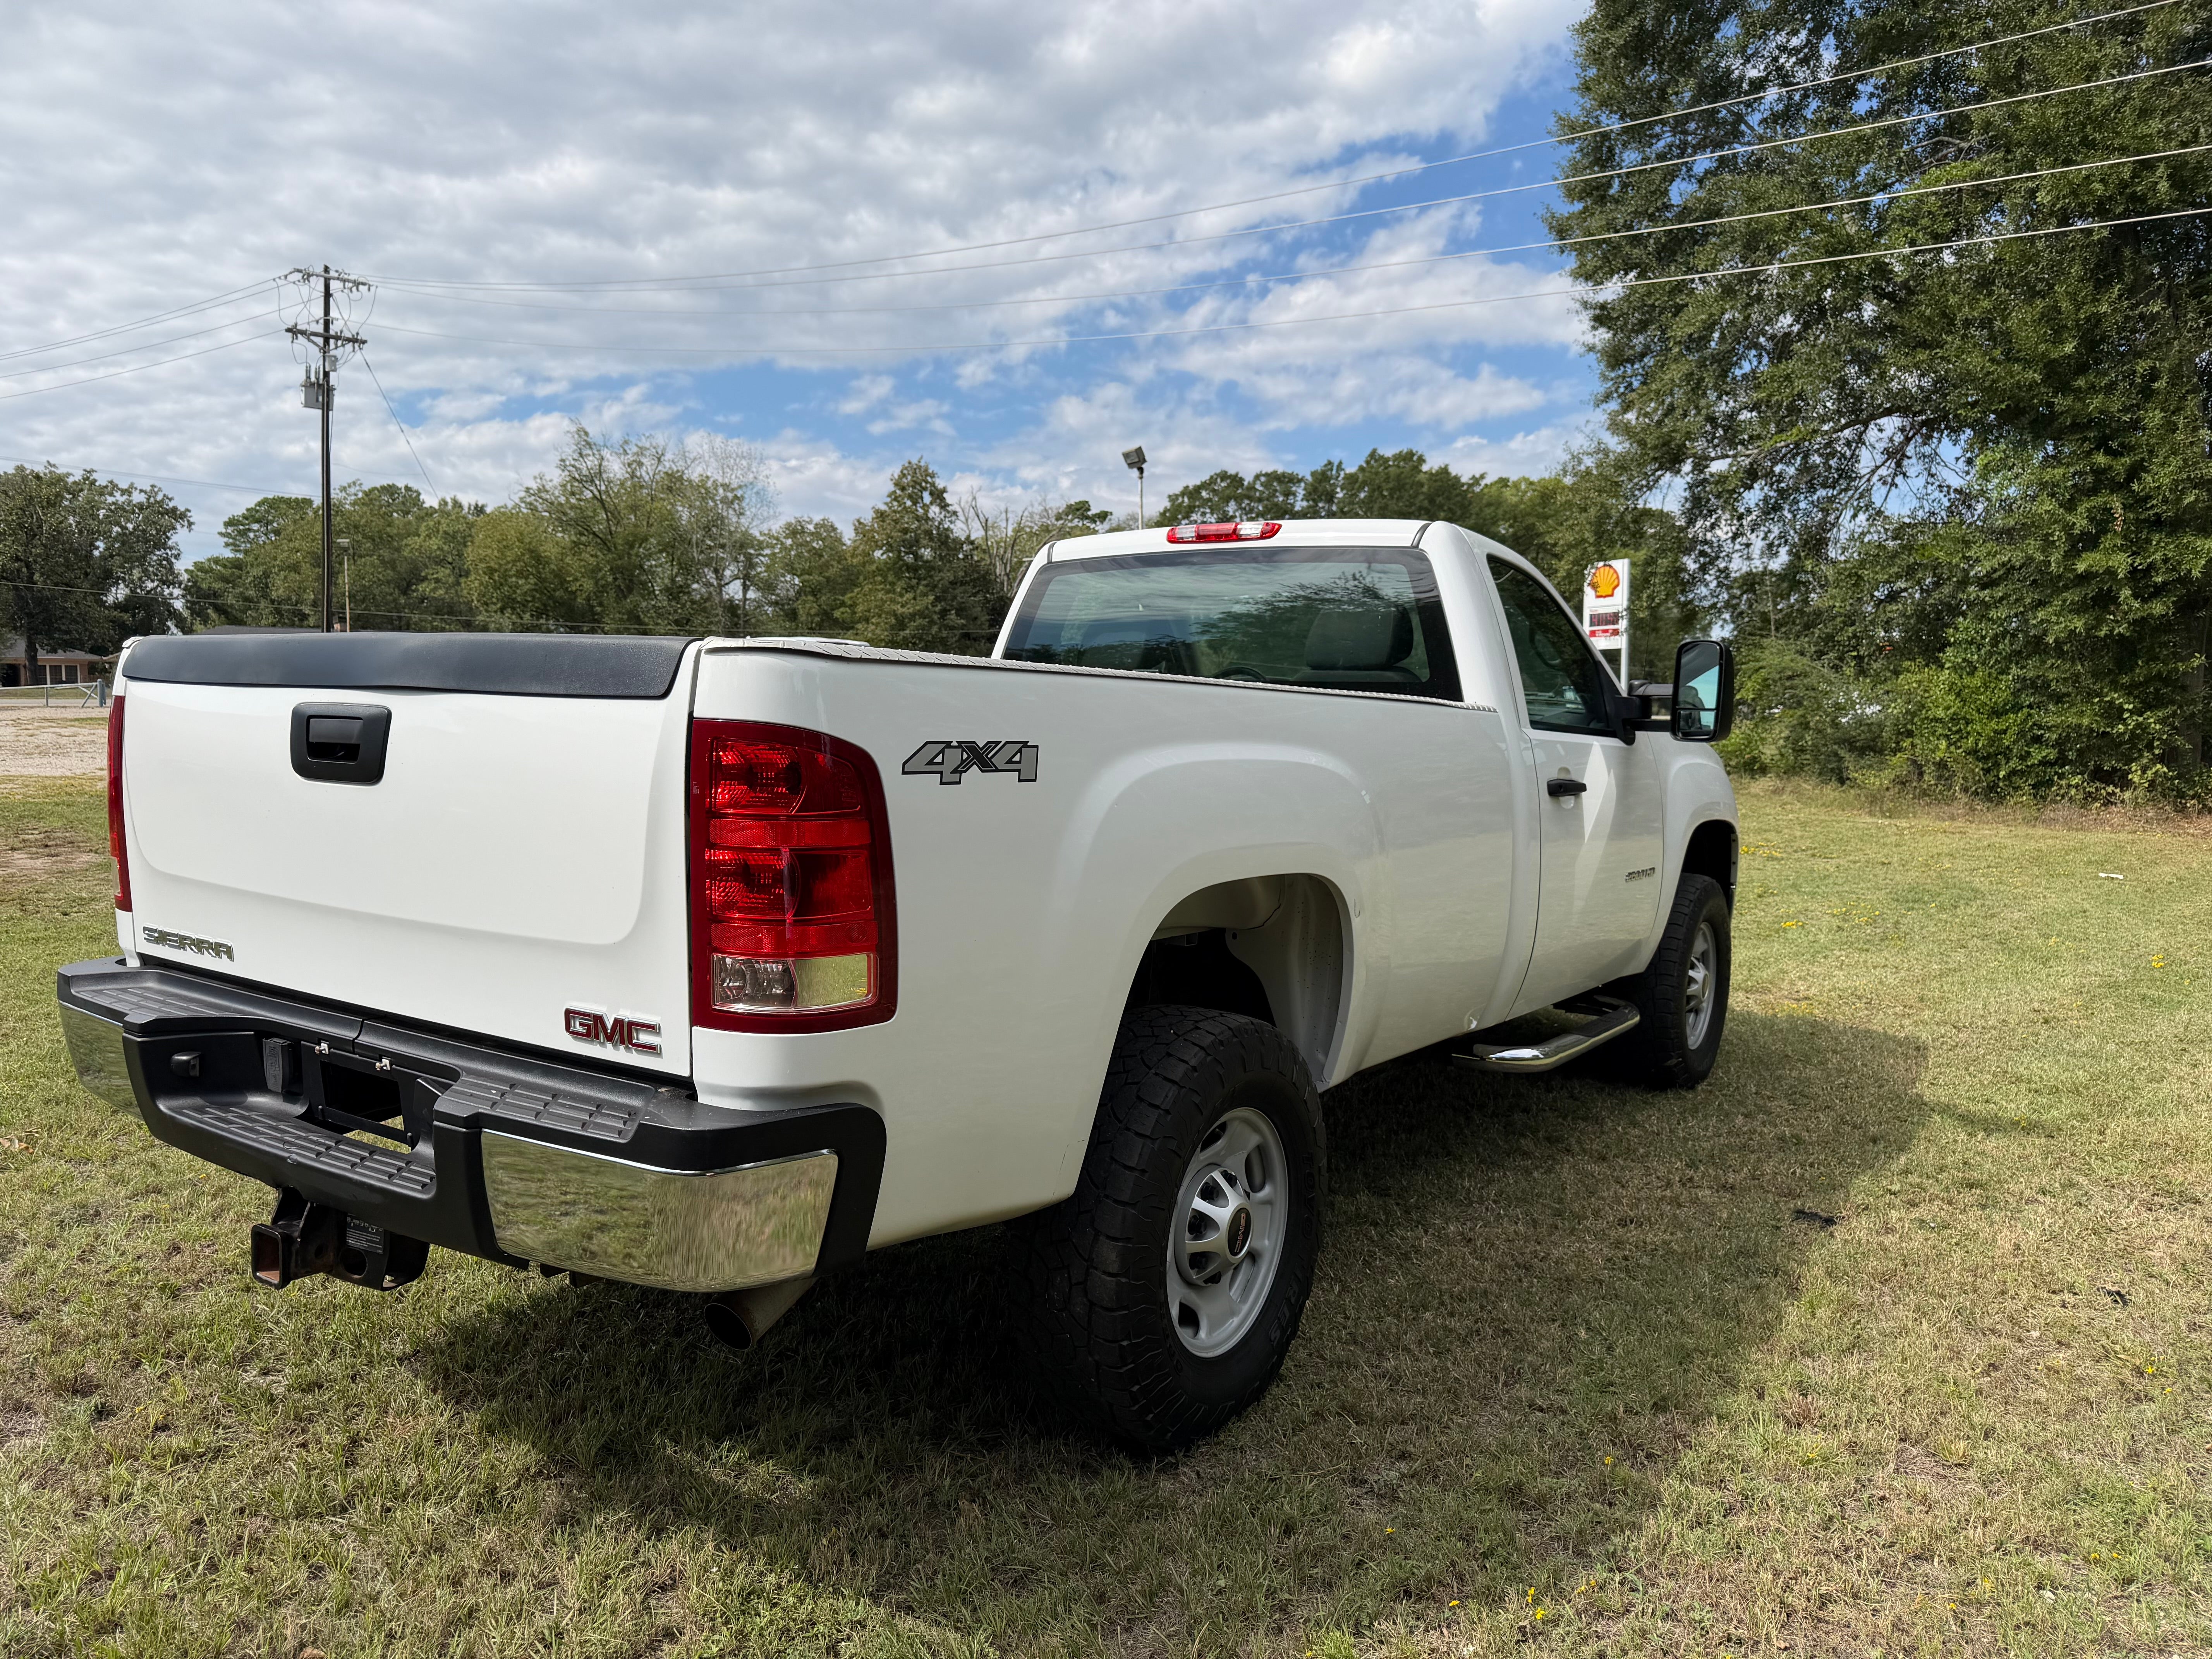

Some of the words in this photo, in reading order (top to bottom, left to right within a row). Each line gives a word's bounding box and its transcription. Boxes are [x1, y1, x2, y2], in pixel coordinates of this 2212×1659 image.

[143, 924, 234, 962] SIERRA
[564, 1006, 661, 1054] GMC
[1302, 1150, 1316, 1239] TOYO
[1234, 1213, 1246, 1253] GMC
